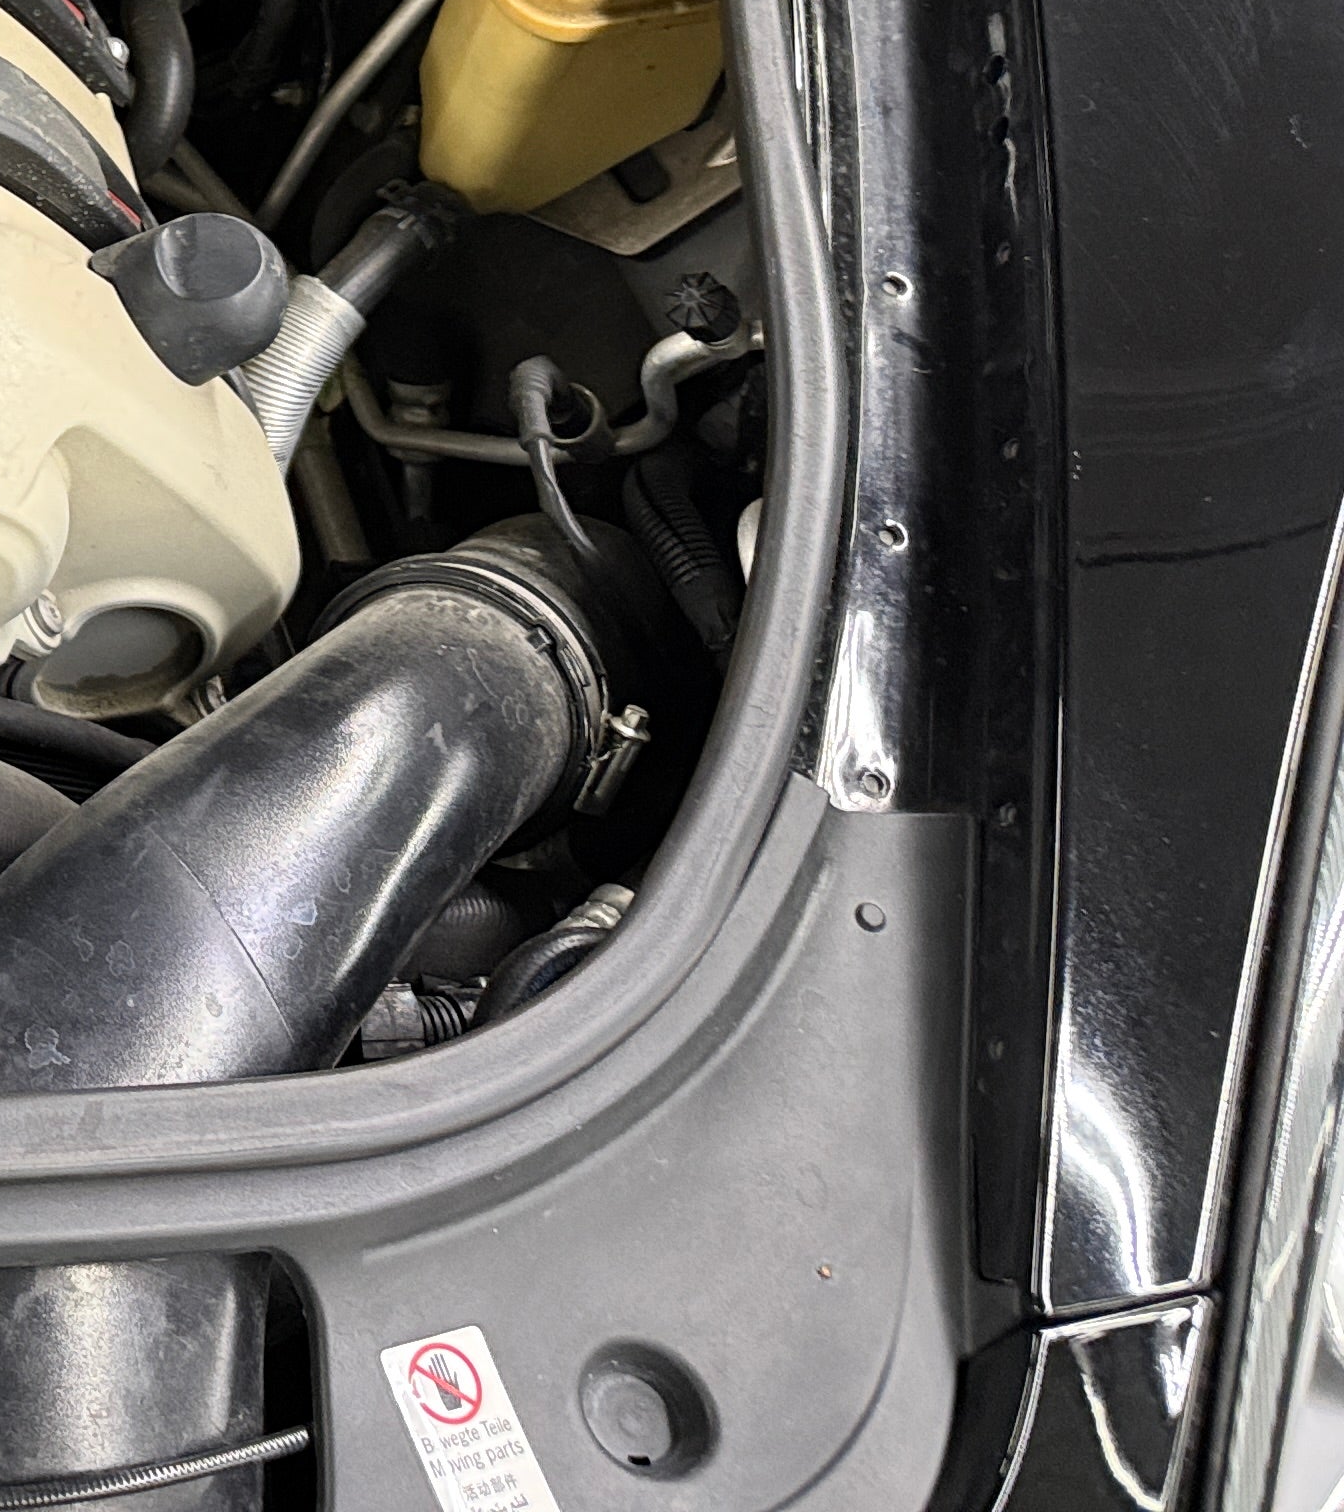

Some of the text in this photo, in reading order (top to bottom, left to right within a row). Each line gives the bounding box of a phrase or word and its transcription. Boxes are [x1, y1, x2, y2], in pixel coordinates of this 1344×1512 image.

[421, 1416, 513, 1455] Bwegte Teile
[485, 1438, 525, 1468] parts
